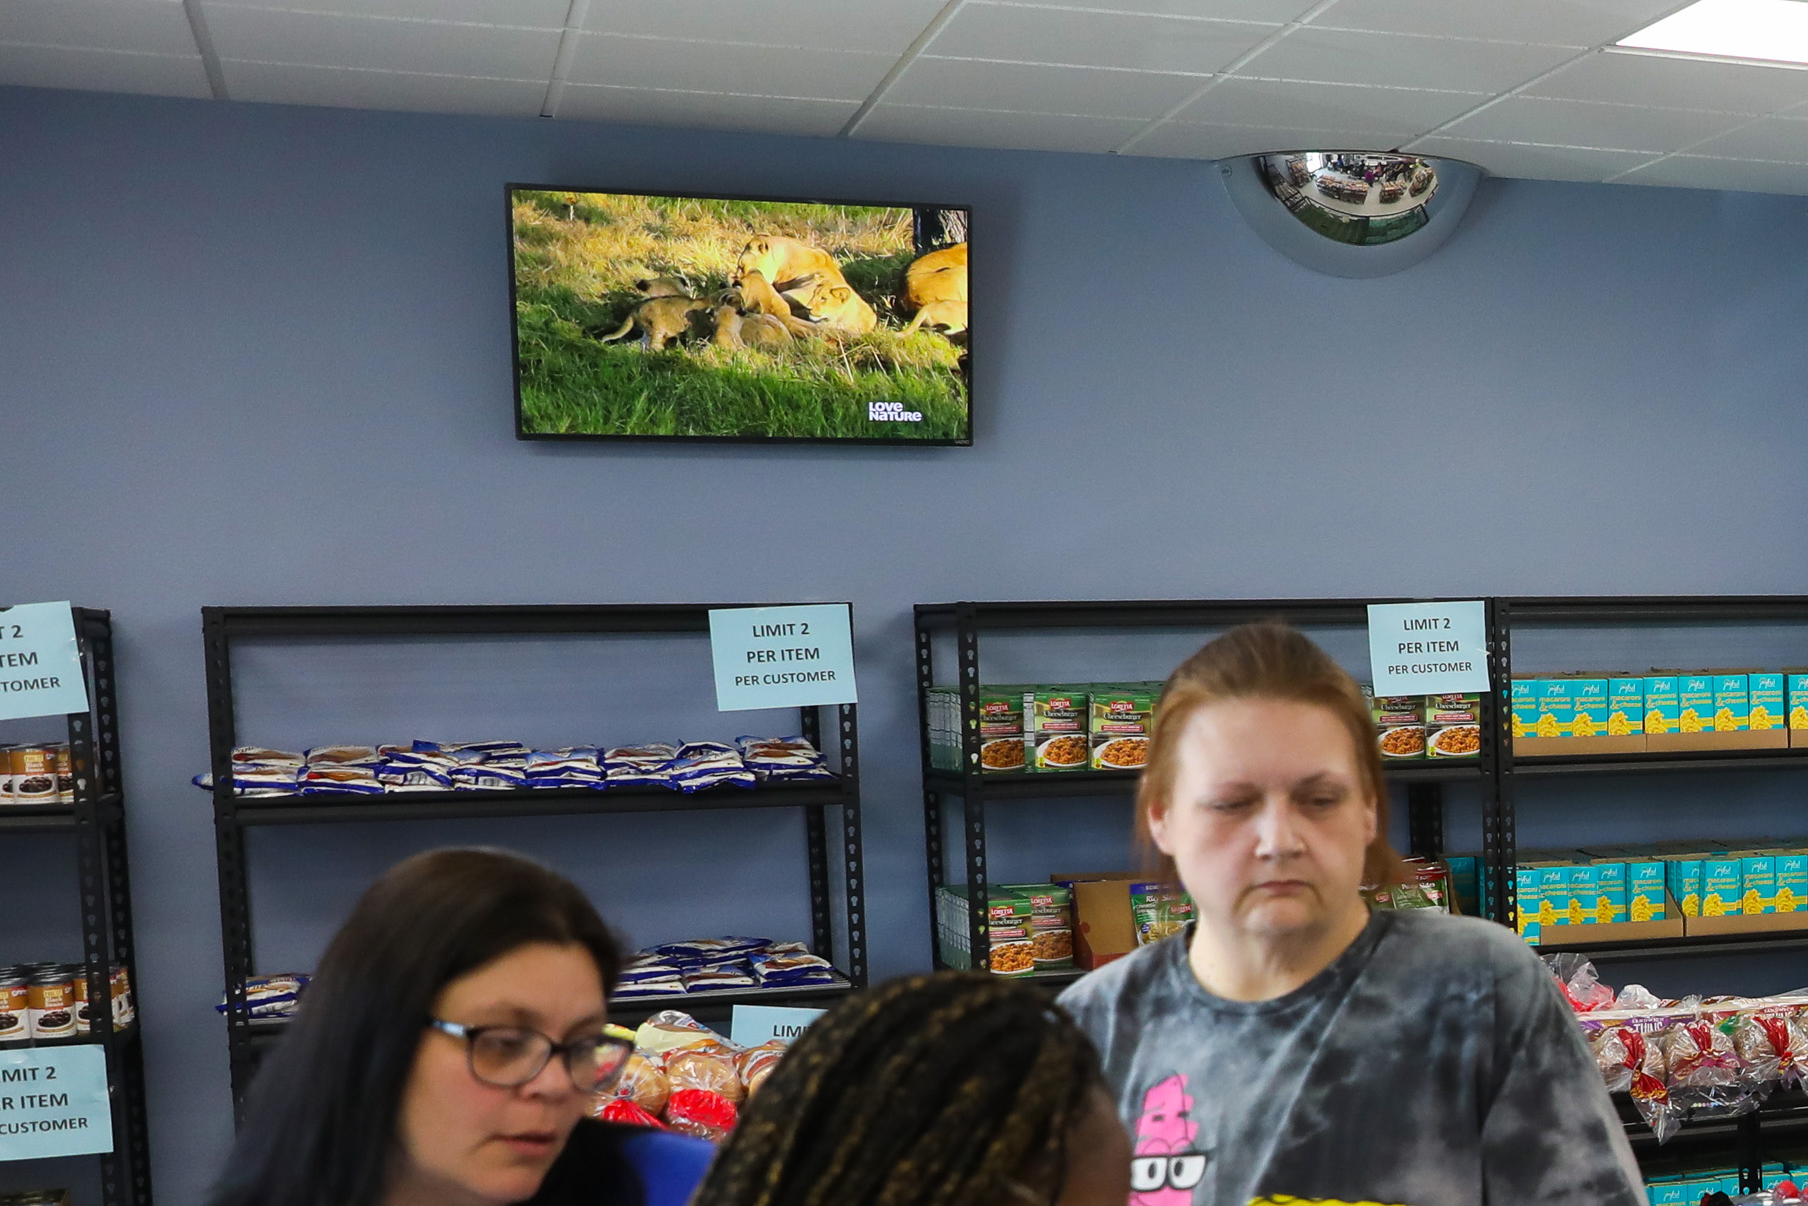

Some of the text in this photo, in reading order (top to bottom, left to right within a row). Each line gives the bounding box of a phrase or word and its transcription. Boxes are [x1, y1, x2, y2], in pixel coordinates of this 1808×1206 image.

[752, 622, 810, 638] LIMIT 2
[1403, 617, 1451, 631] LIMIT 2
[11, 624, 24, 639] 2
[1398, 640, 1459, 654] PER ITEM
[746, 647, 820, 663] PER ITEM
[1388, 661, 1473, 675] PER CUSTOMER
[0, 677, 61, 693] TOMER
[735, 670, 836, 687] PER CUSTOMER
[1050, 700, 1070, 708] LORETTA
[1111, 703, 1133, 711] LORETTA
[1435, 702, 1472, 711] Cheeseburger
[1043, 710, 1079, 720] Cheeseburger
[1103, 712, 1142, 722] Cheeseburger
[46, 1066, 57, 1080] 2
[21, 1093, 68, 1109] ITEM
[0, 1117, 88, 1135] CUSTOMER
